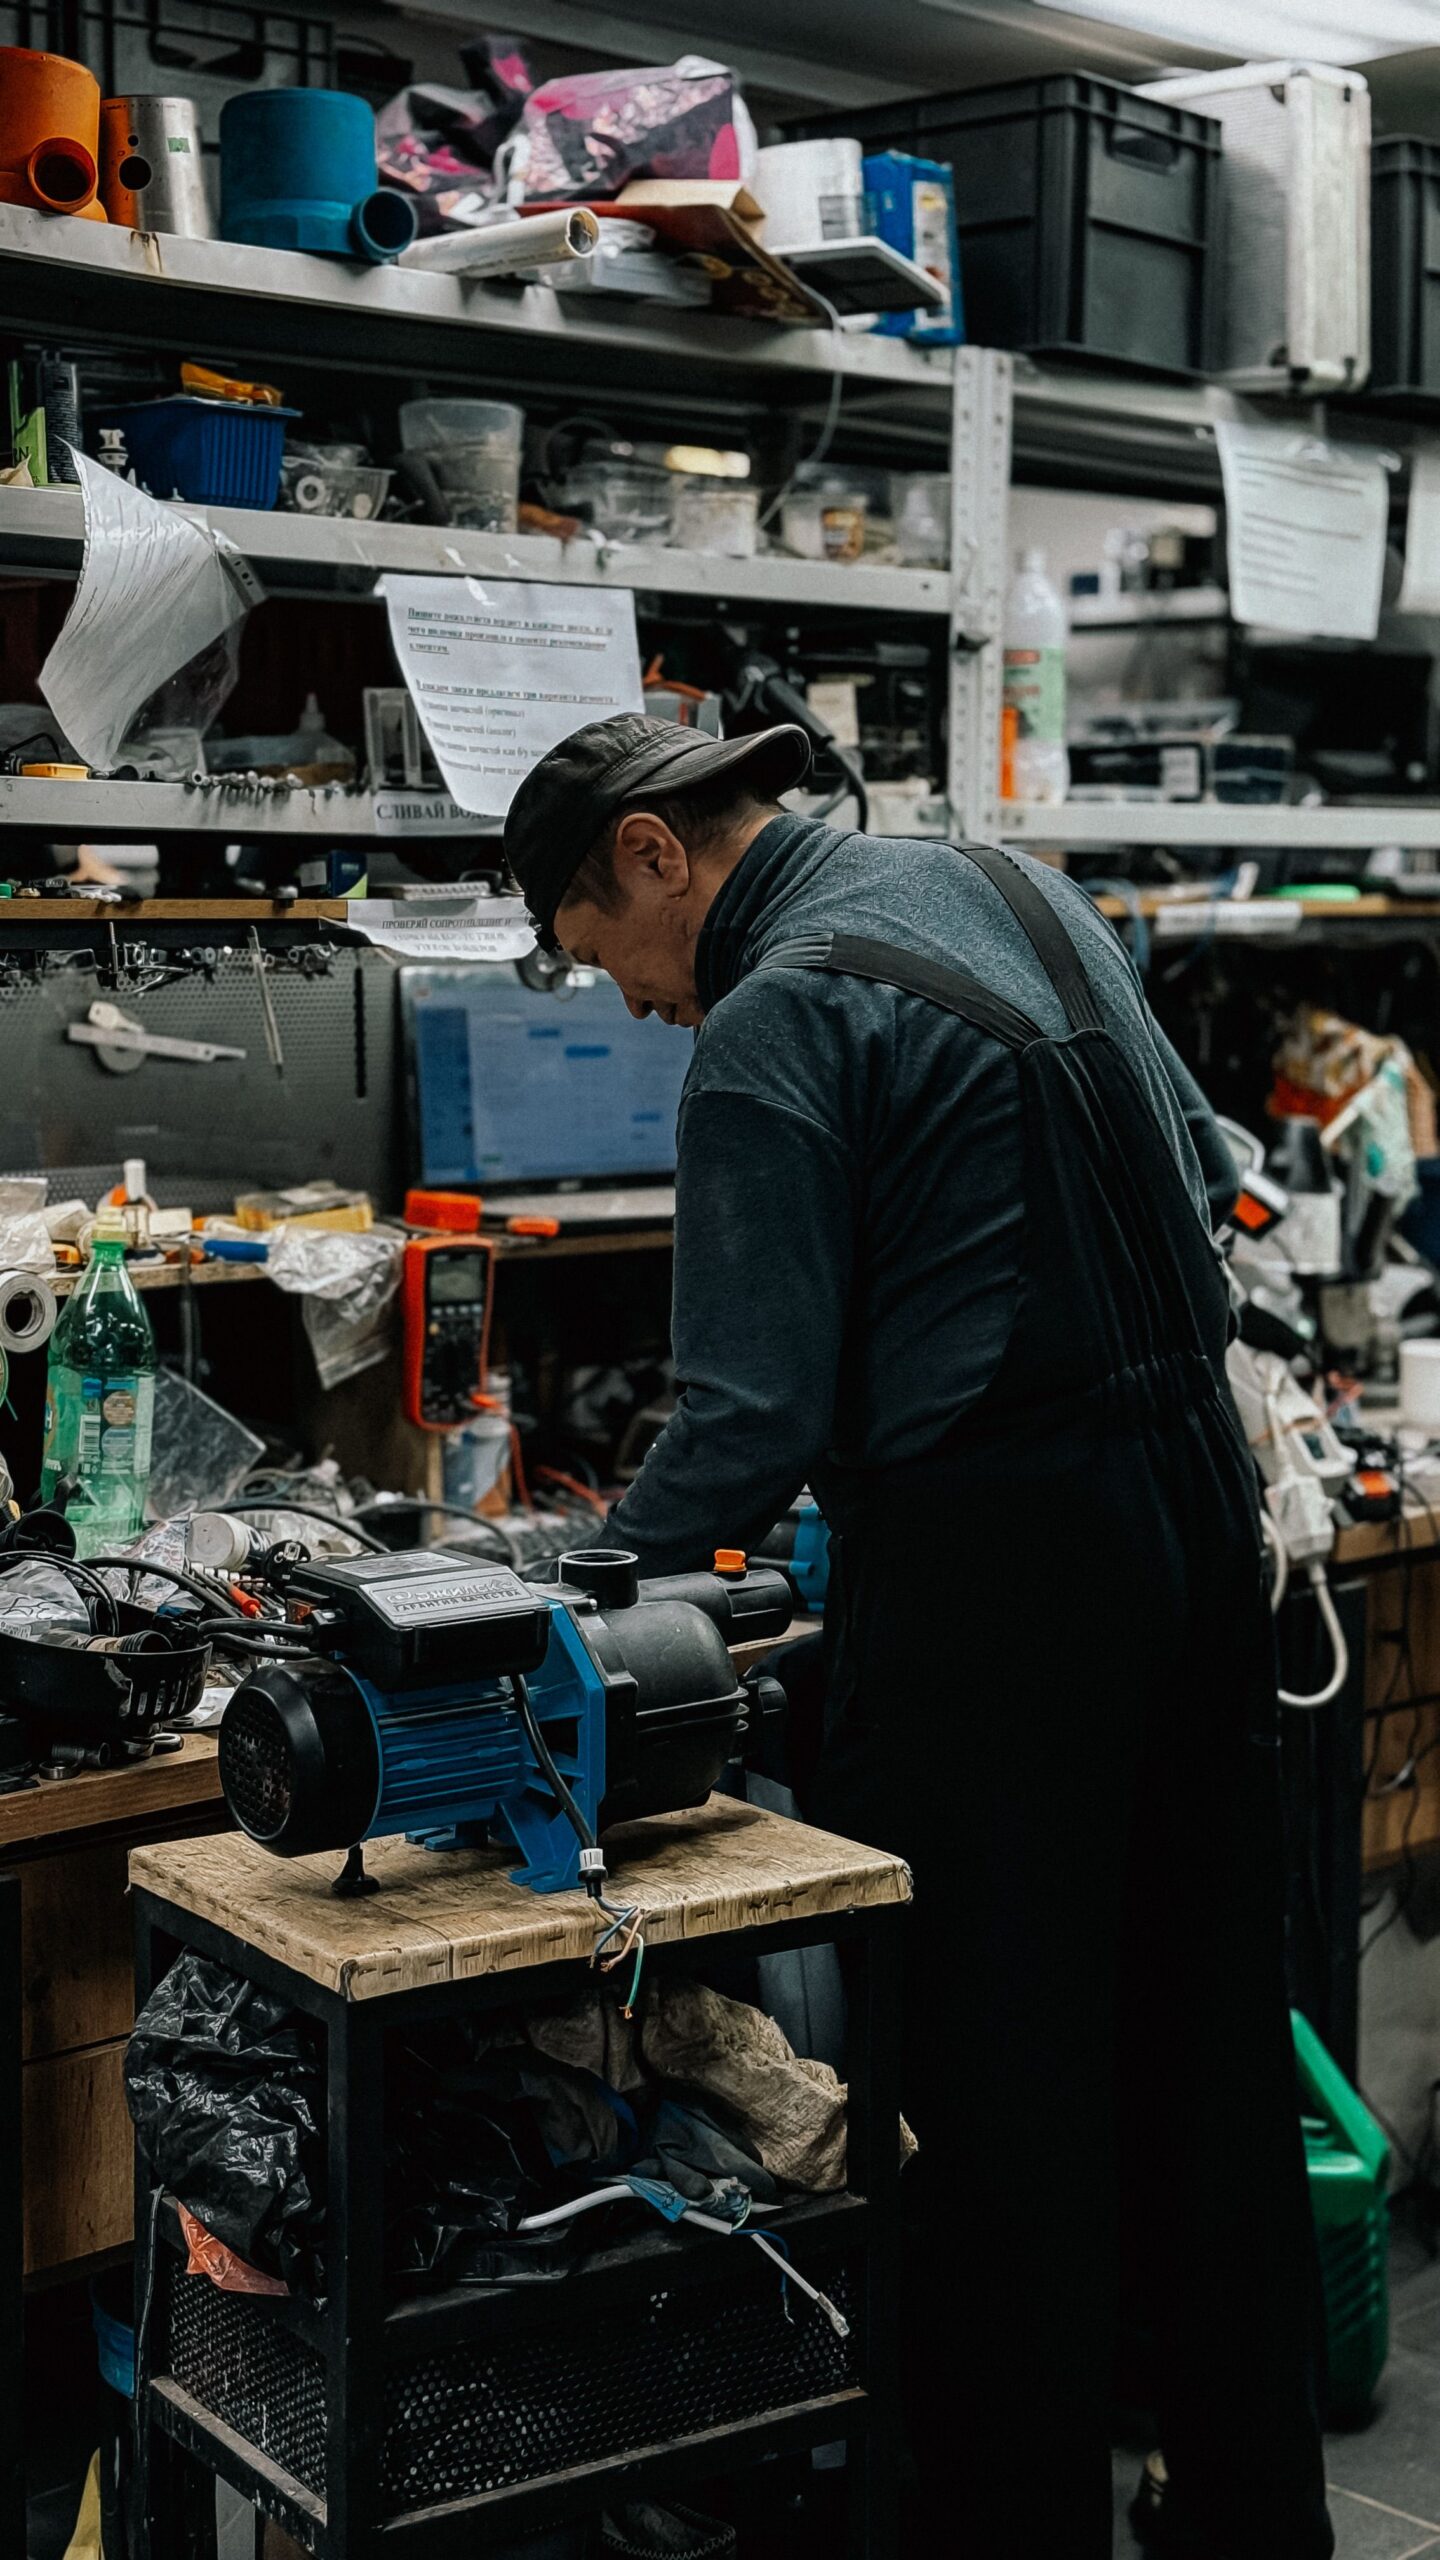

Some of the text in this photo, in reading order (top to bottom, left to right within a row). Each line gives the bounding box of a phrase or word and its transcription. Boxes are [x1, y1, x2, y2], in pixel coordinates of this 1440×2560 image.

[376, 801, 444, 820] СЛИВАЙ
[382, 917, 428, 930] ПРОВЕРЯЙ
[393, 1589, 523, 1613] ГАРАНТИЯ КАЧЕСТВА
